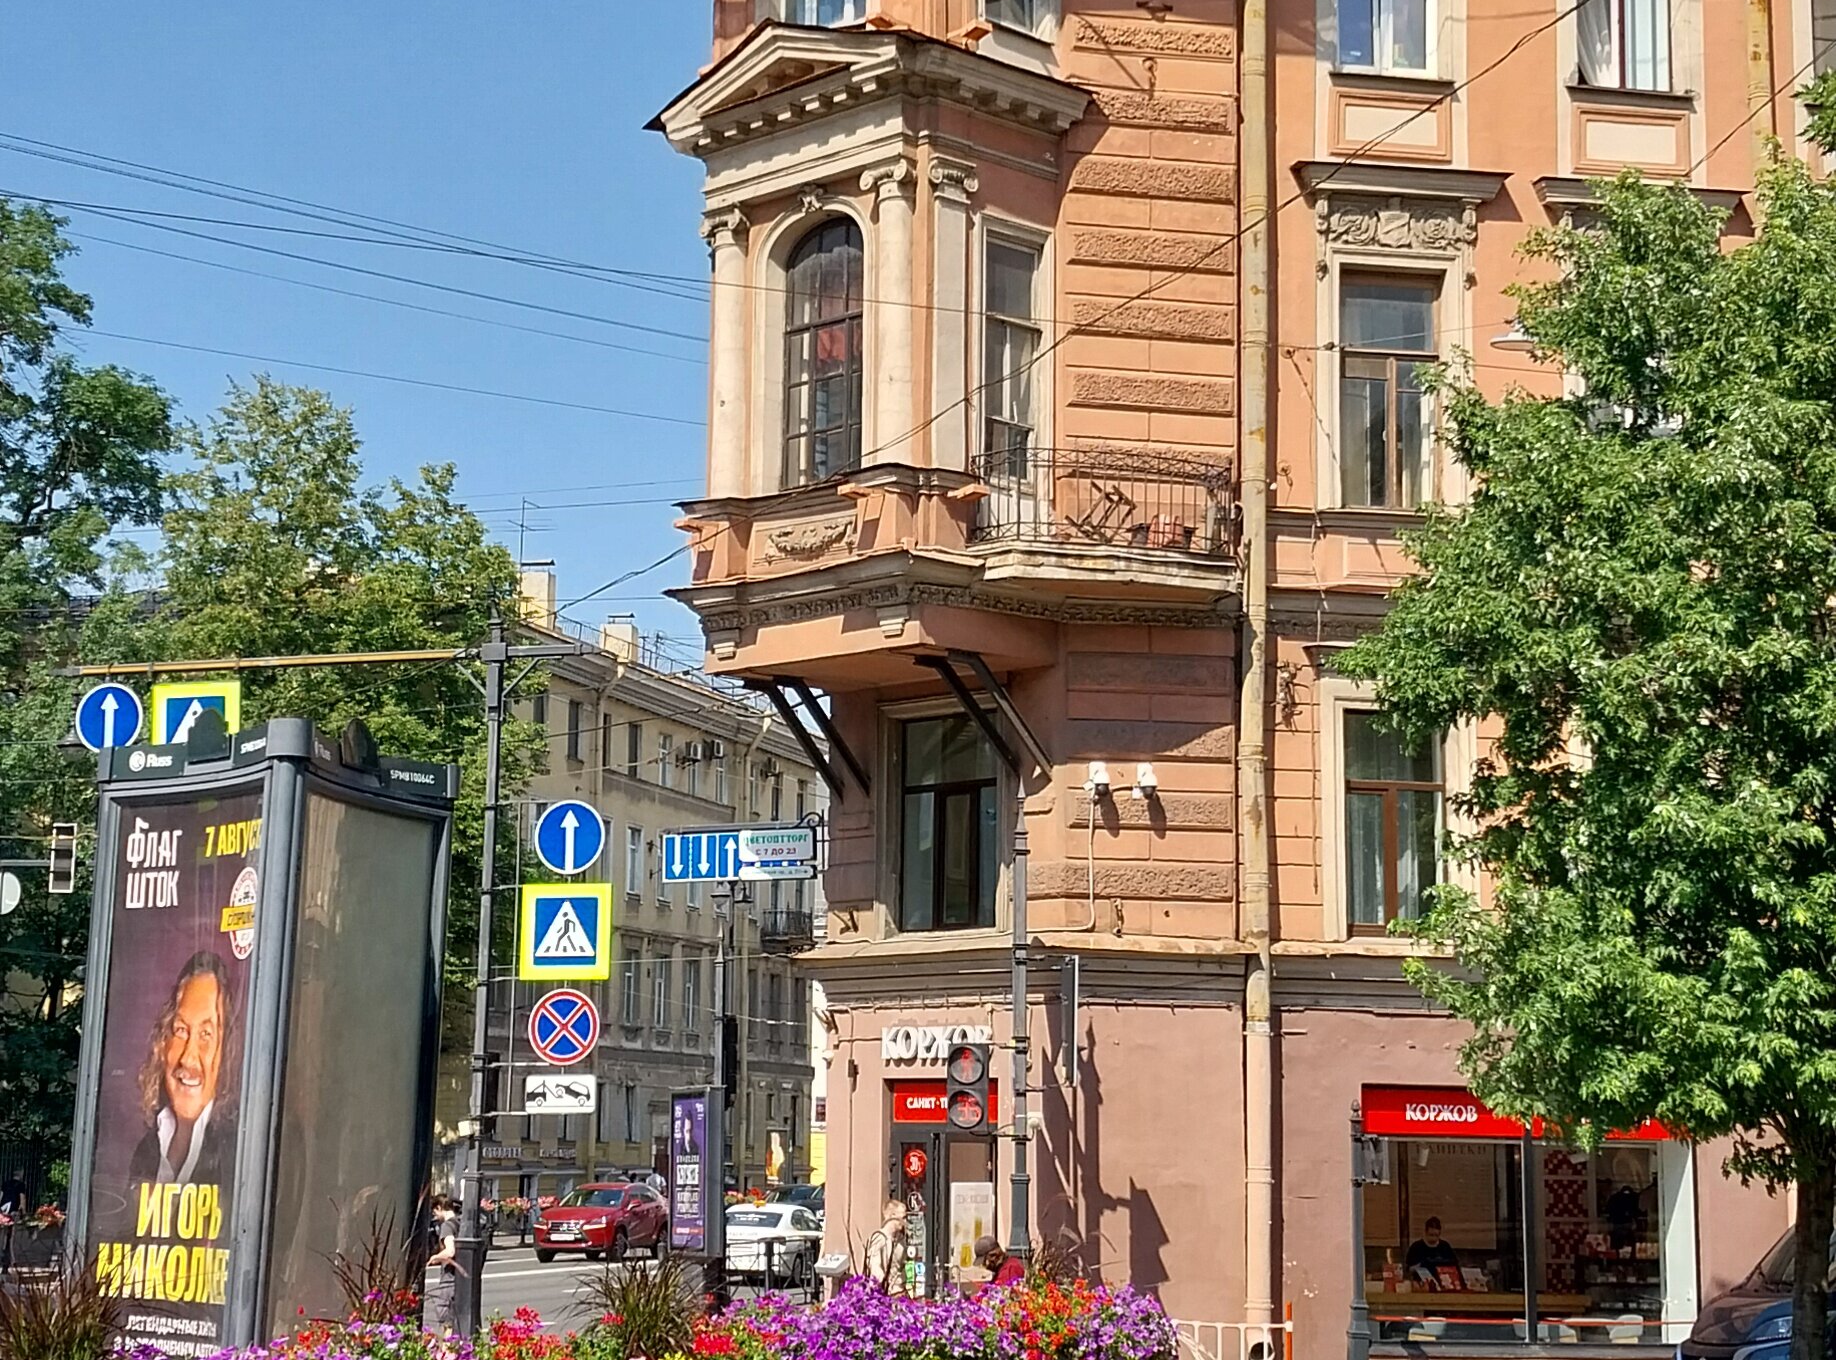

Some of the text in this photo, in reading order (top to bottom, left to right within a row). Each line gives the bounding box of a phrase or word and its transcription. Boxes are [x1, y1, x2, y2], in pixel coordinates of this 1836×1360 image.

[146, 754, 173, 767] Russ
[126, 817, 183, 868] ФЛАГ
[205, 826, 216, 857] 7
[771, 848, 784, 856] ДО
[125, 871, 180, 909] ШТОК
[1405, 1103, 1478, 1123] КОРЖОВ
[136, 1182, 222, 1240] ИГОРЬ
